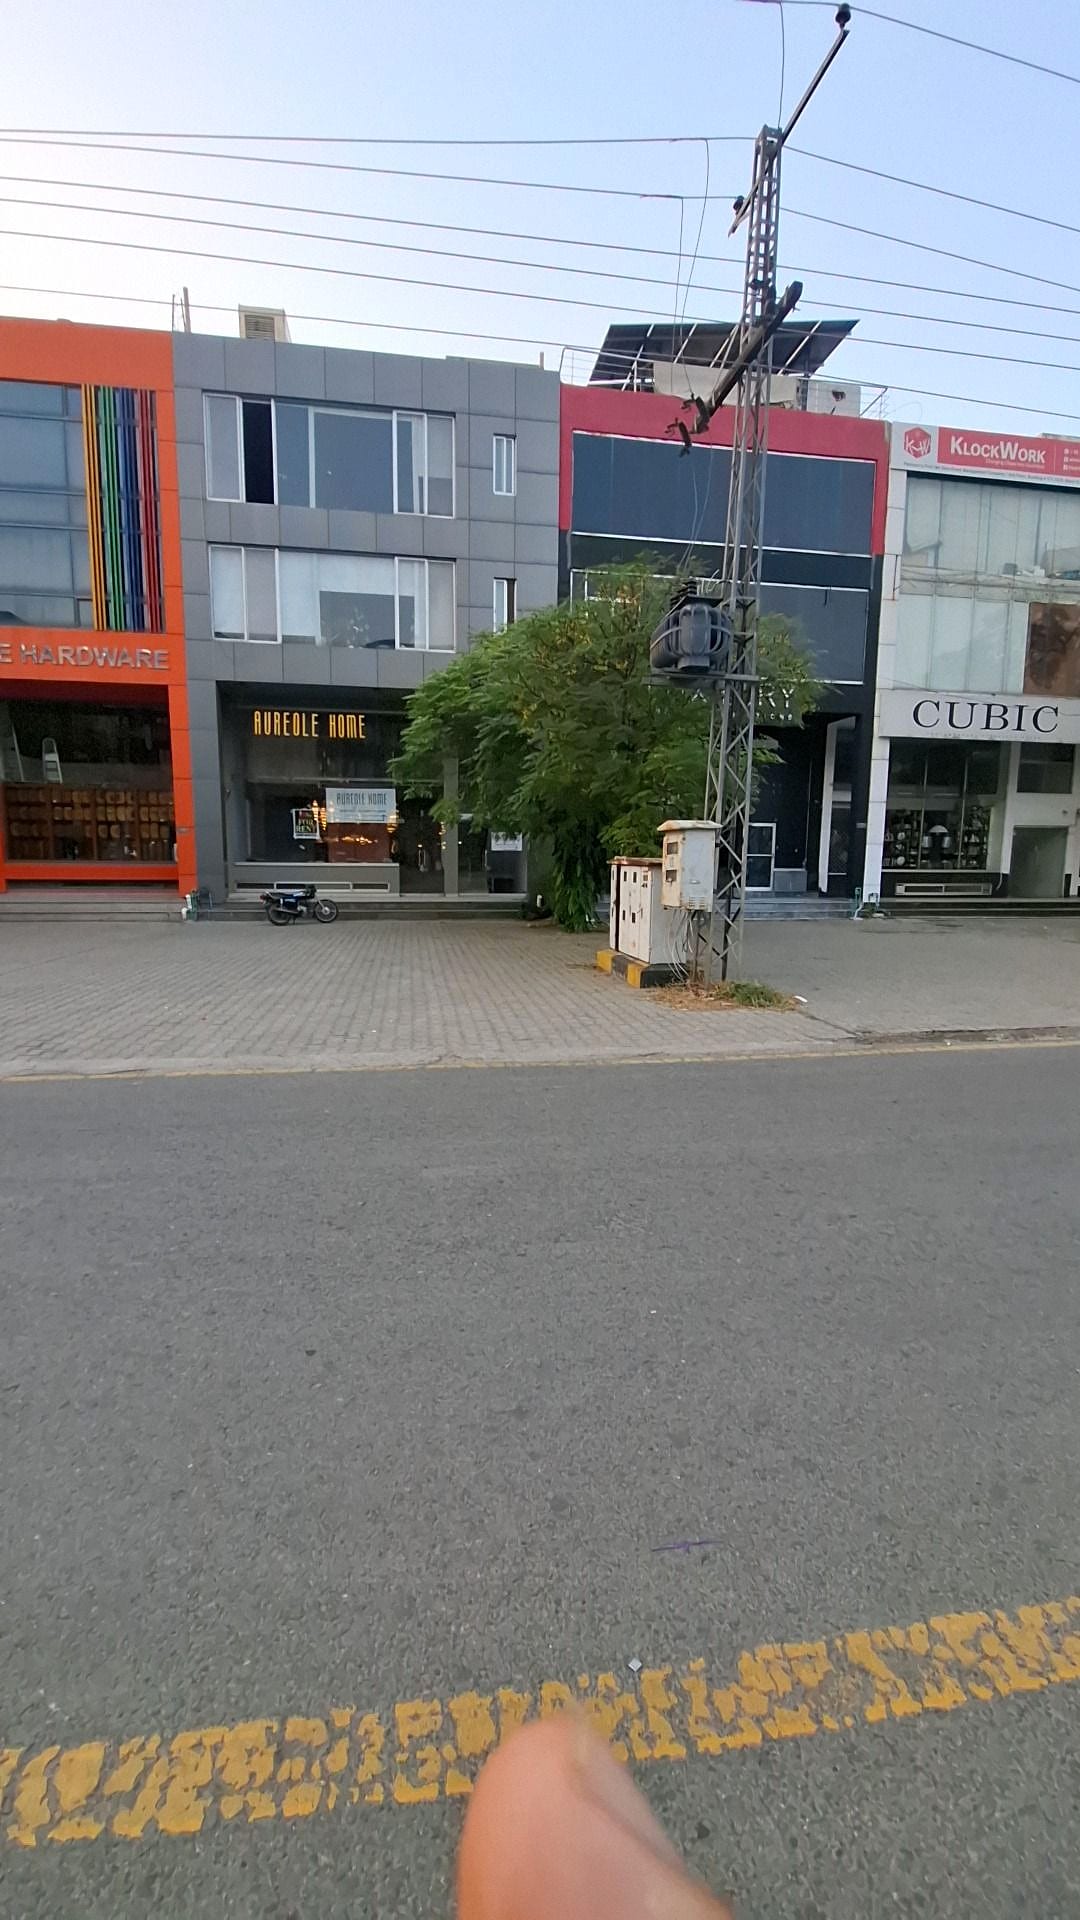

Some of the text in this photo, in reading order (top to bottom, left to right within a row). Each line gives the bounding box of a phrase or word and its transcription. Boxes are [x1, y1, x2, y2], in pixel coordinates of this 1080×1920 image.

[20, 643, 169, 671] HARDWARE
[253, 710, 366, 739] AUREOLE HOME
[912, 699, 1059, 733] CUBIC
